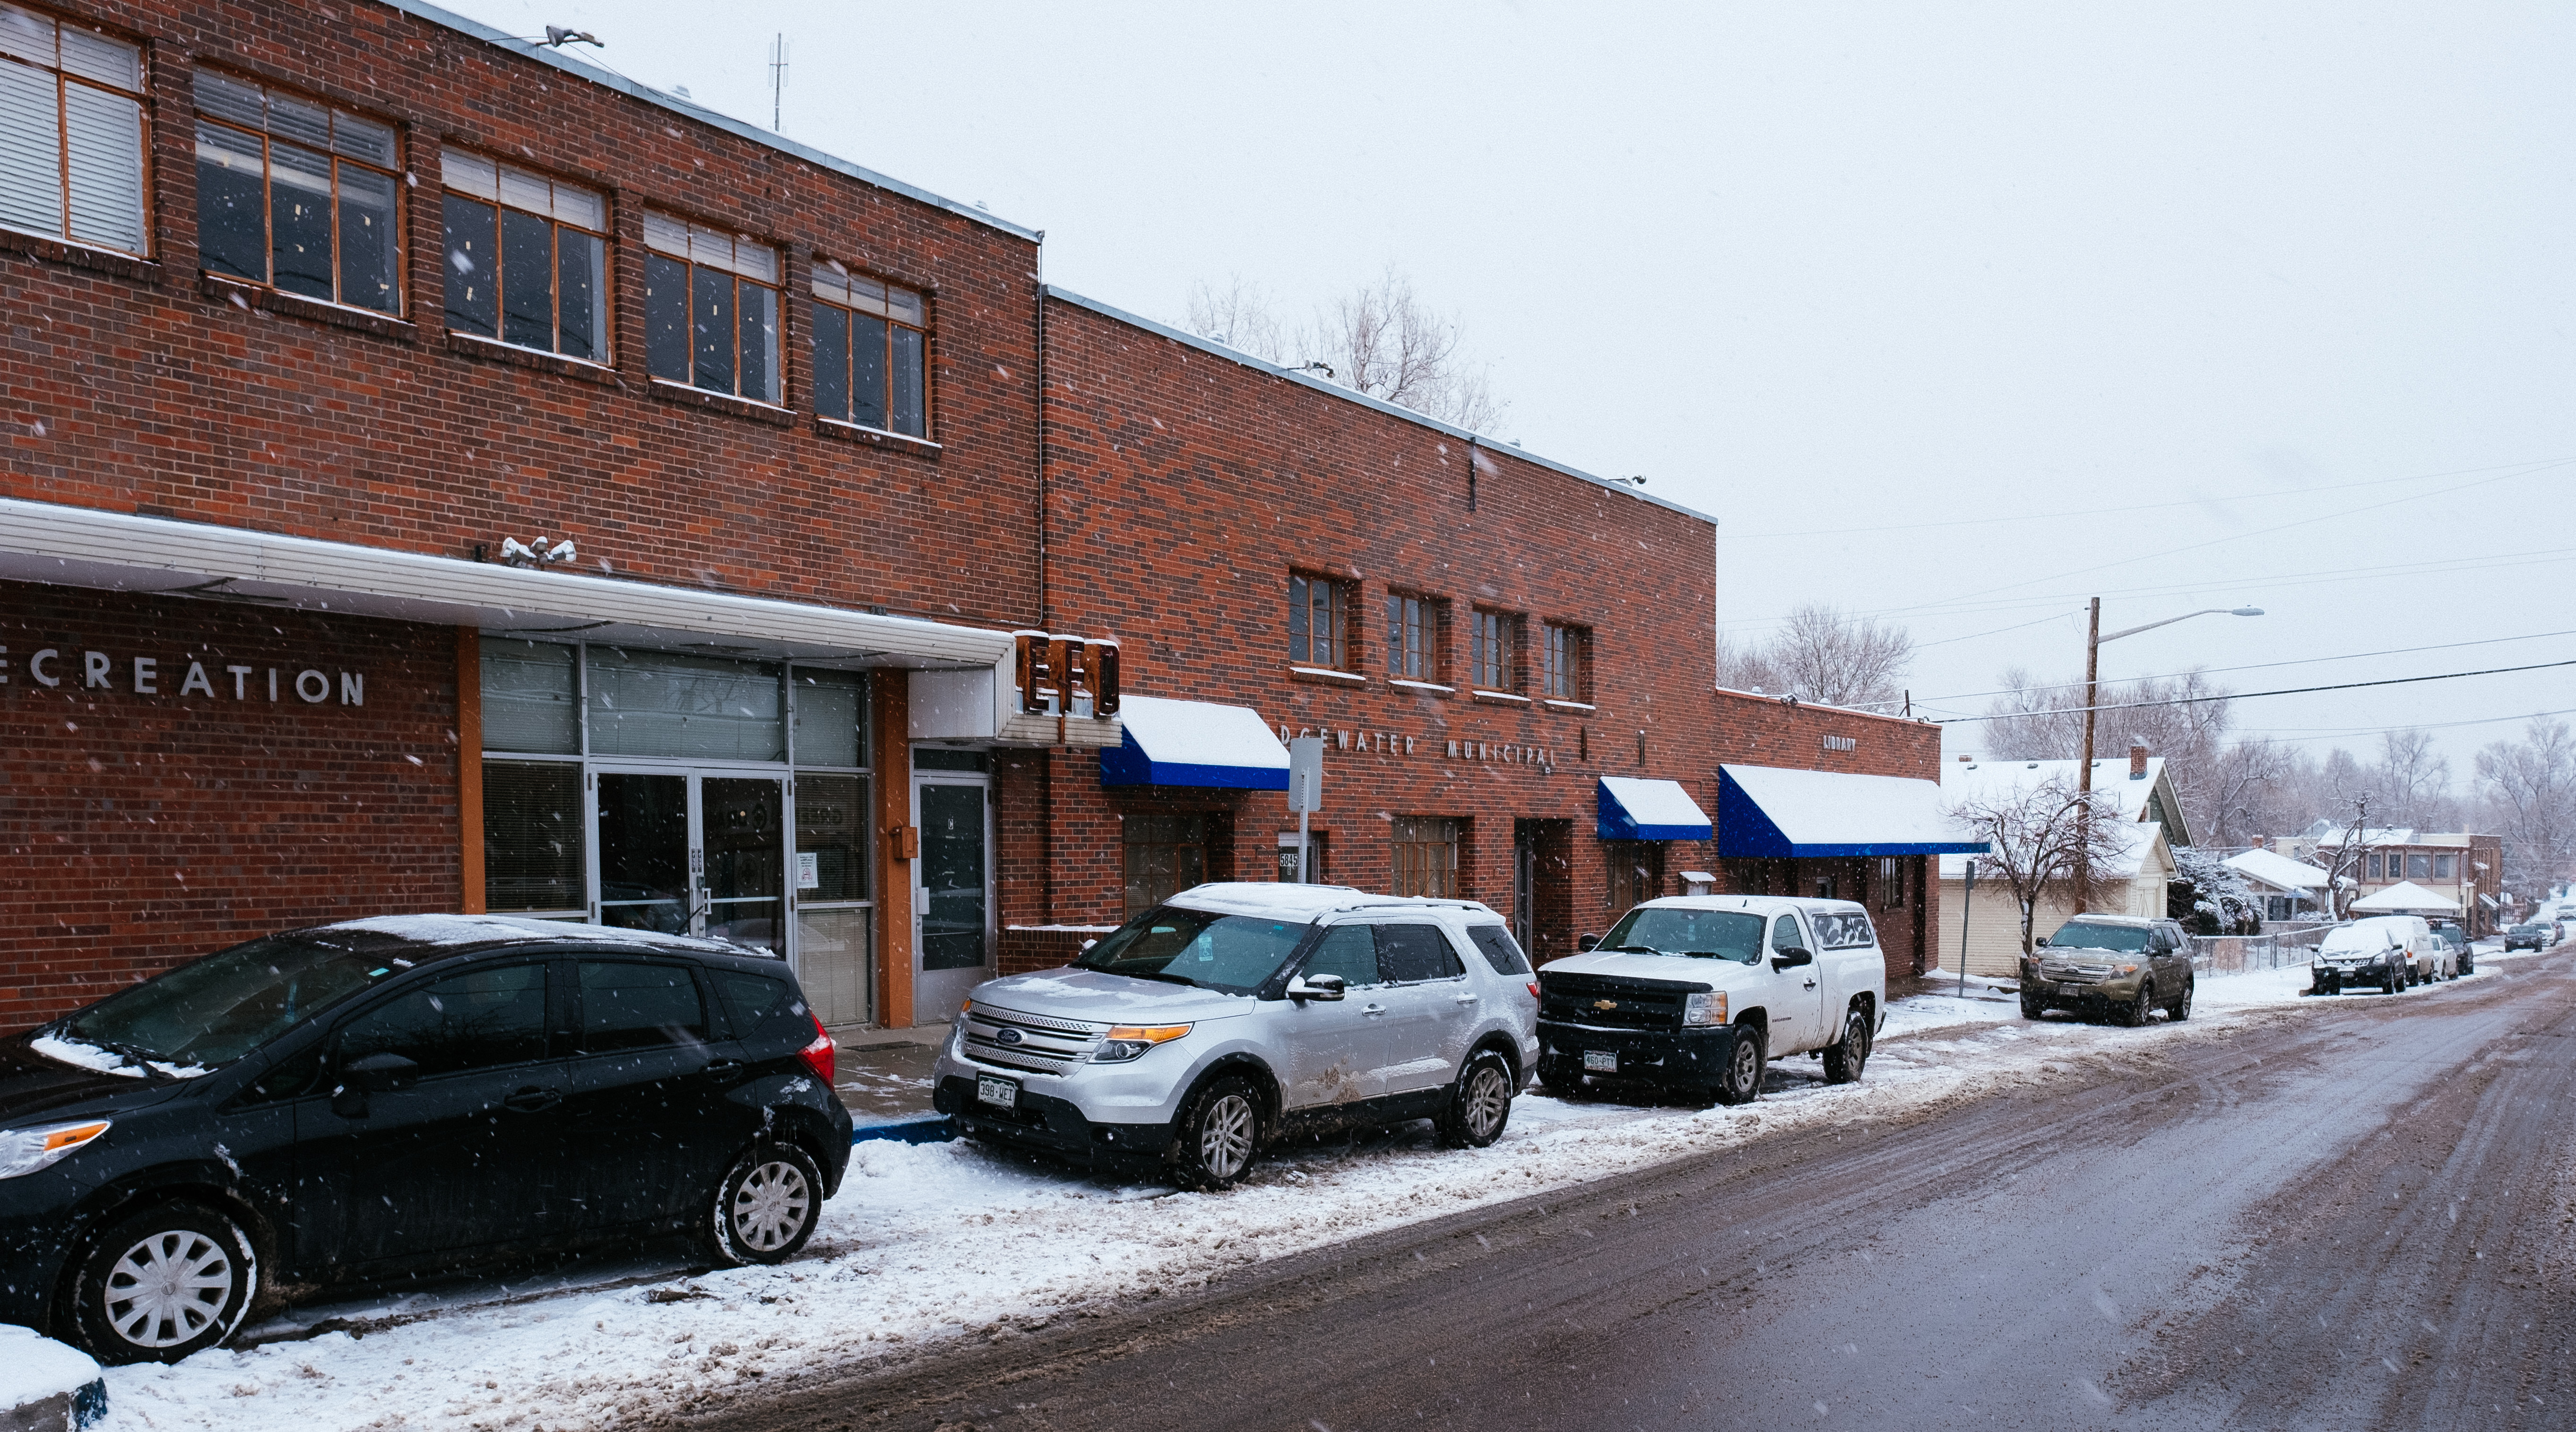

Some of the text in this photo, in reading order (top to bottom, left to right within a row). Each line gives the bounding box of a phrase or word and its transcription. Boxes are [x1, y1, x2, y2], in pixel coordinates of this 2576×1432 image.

[1027, 635, 1120, 715] EFD
[1823, 735, 1856, 752] LIBRARY
[1448, 740, 1556, 766] MUNICIPAL
[1280, 854, 1297, 866] 5845
[1001, 1031, 1017, 1041] Ford
